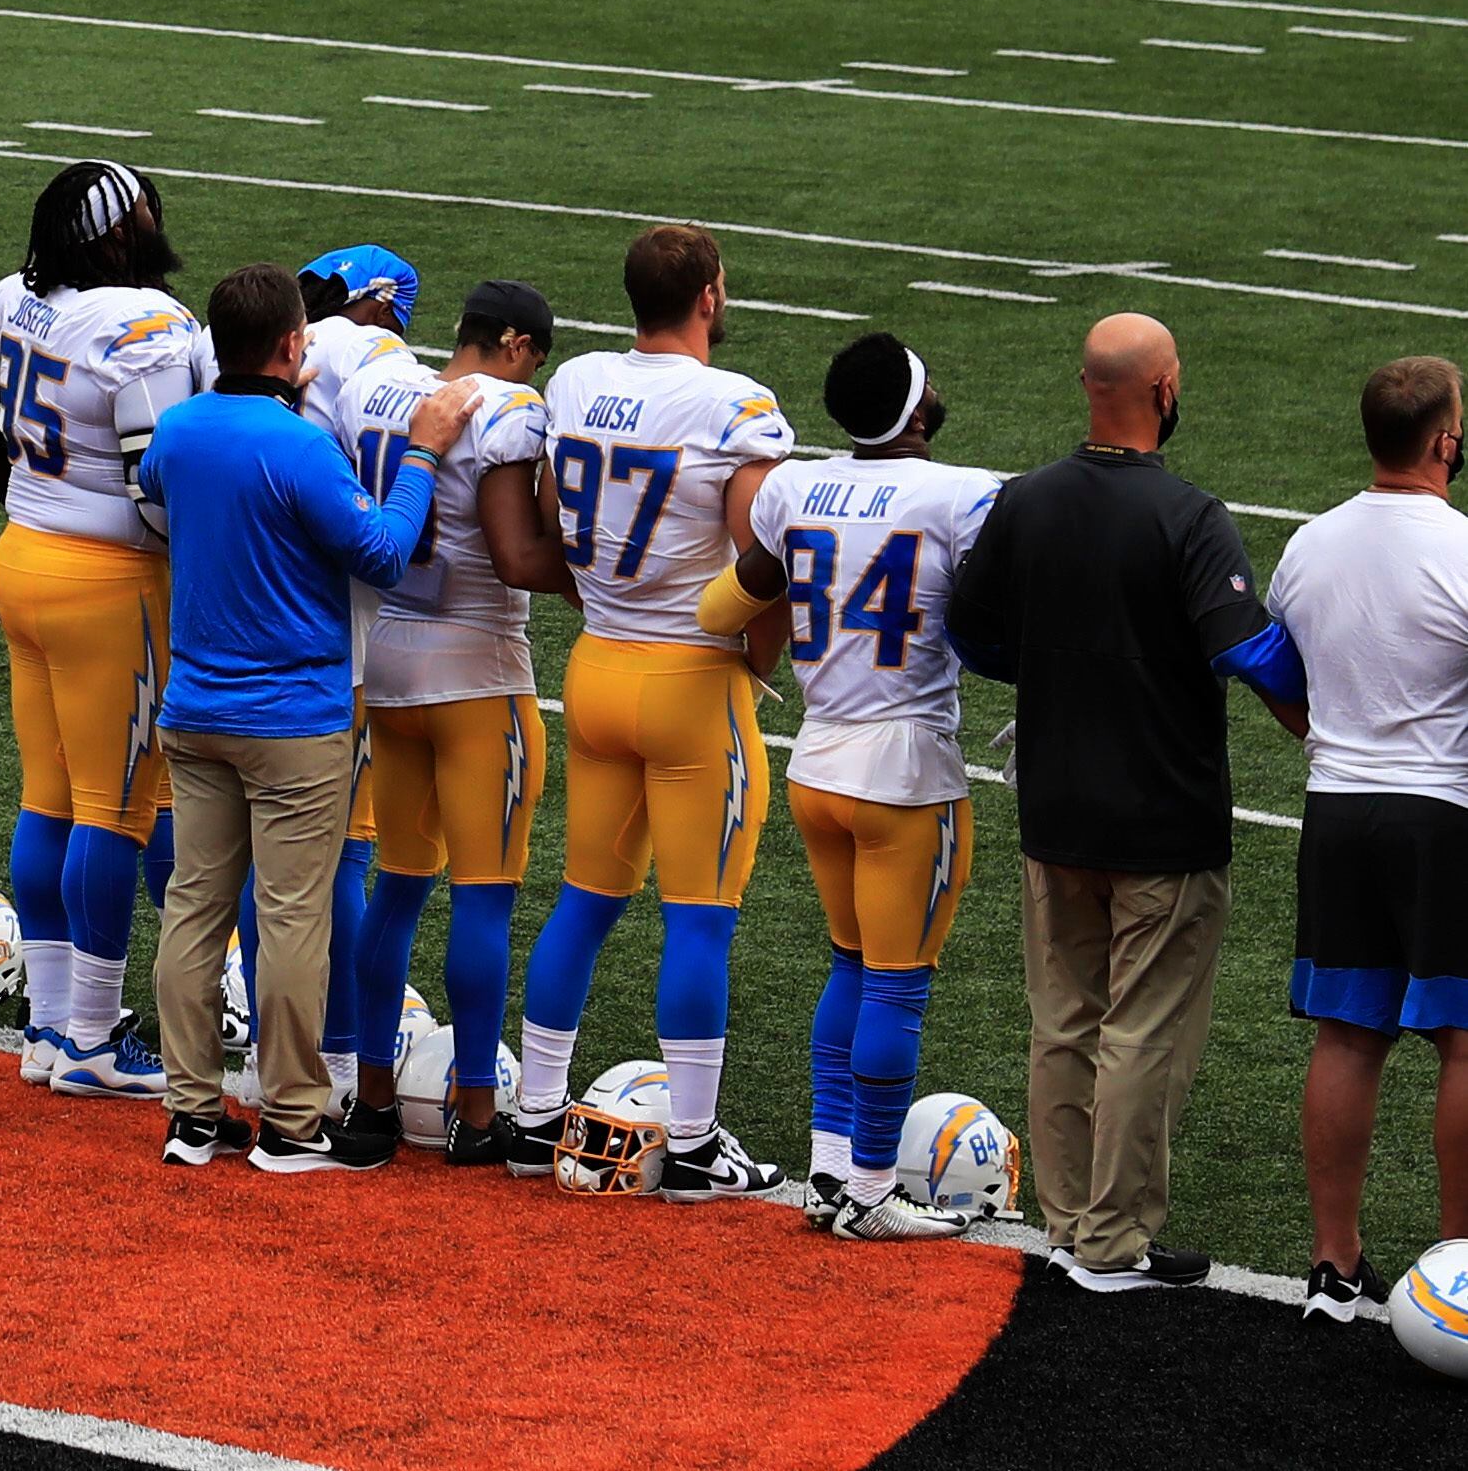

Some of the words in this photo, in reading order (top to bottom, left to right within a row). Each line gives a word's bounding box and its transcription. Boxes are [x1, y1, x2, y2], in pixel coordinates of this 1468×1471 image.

[8, 293, 62, 336] JOSEPH
[364, 384, 432, 421] GUYT
[584, 395, 644, 432] BOSA
[554, 433, 684, 582] 97
[802, 482, 852, 518] HILL
[858, 485, 898, 519] JR
[782, 524, 925, 670] 84
[969, 1127, 1000, 1167] 84
